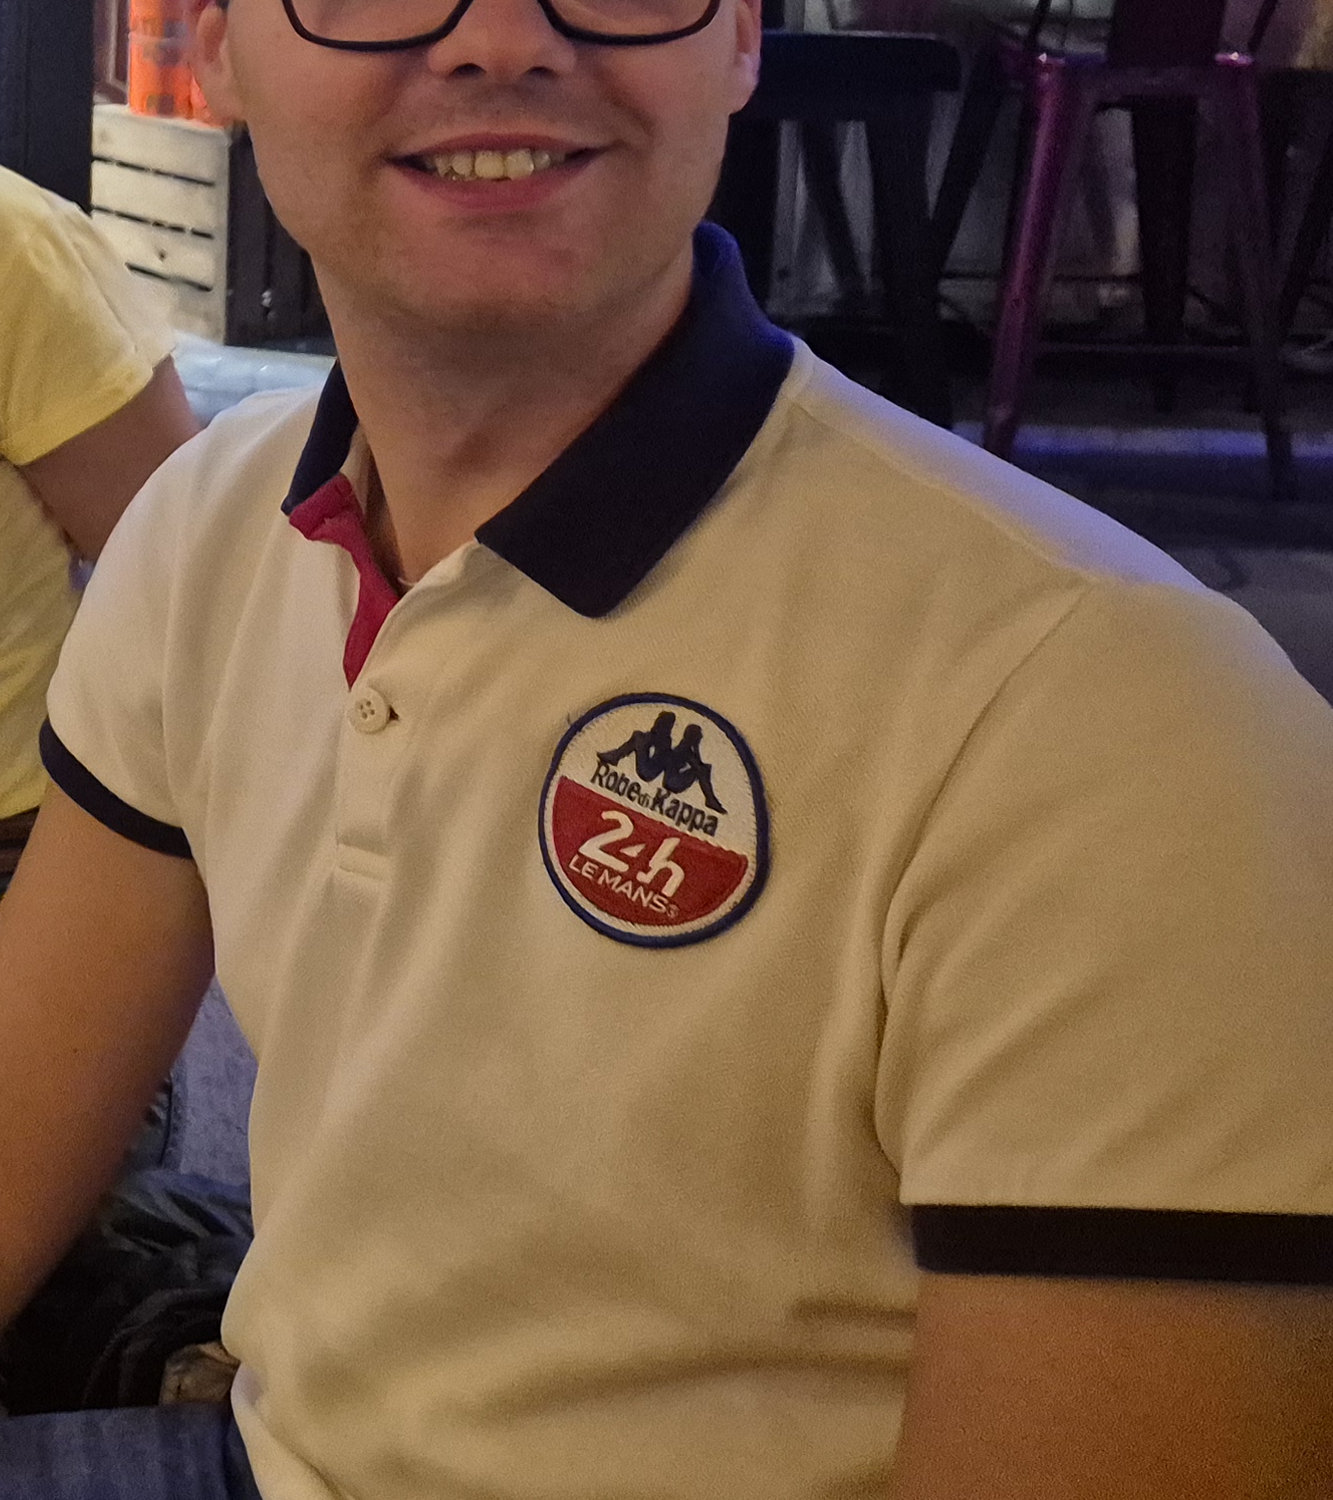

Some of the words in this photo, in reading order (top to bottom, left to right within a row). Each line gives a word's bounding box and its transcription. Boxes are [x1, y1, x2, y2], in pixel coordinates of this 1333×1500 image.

[590, 760, 641, 801] Robe
[648, 786, 719, 837] Kappa
[568, 853, 599, 878] LE
